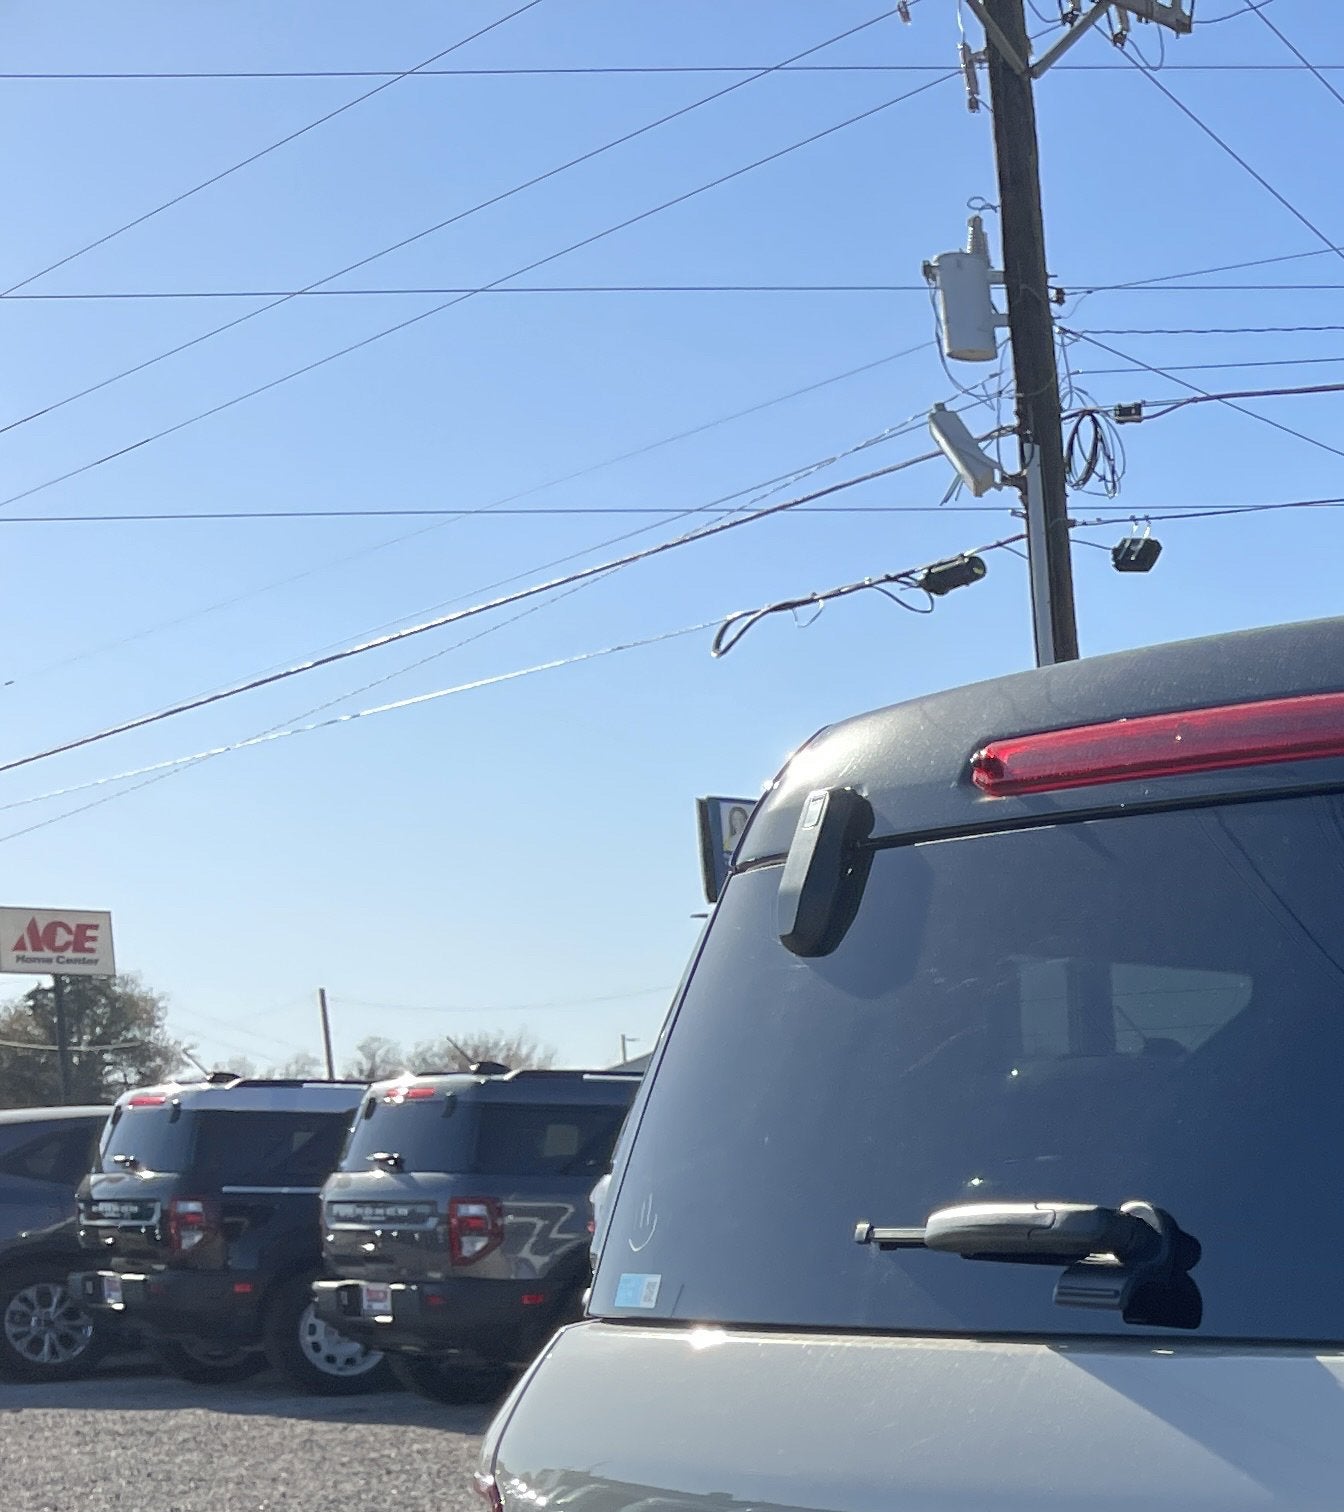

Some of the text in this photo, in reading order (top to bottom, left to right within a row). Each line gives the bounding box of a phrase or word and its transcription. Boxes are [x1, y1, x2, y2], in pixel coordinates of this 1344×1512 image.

[11, 916, 99, 954] ACE
[16, 955, 99, 966] Home Center
